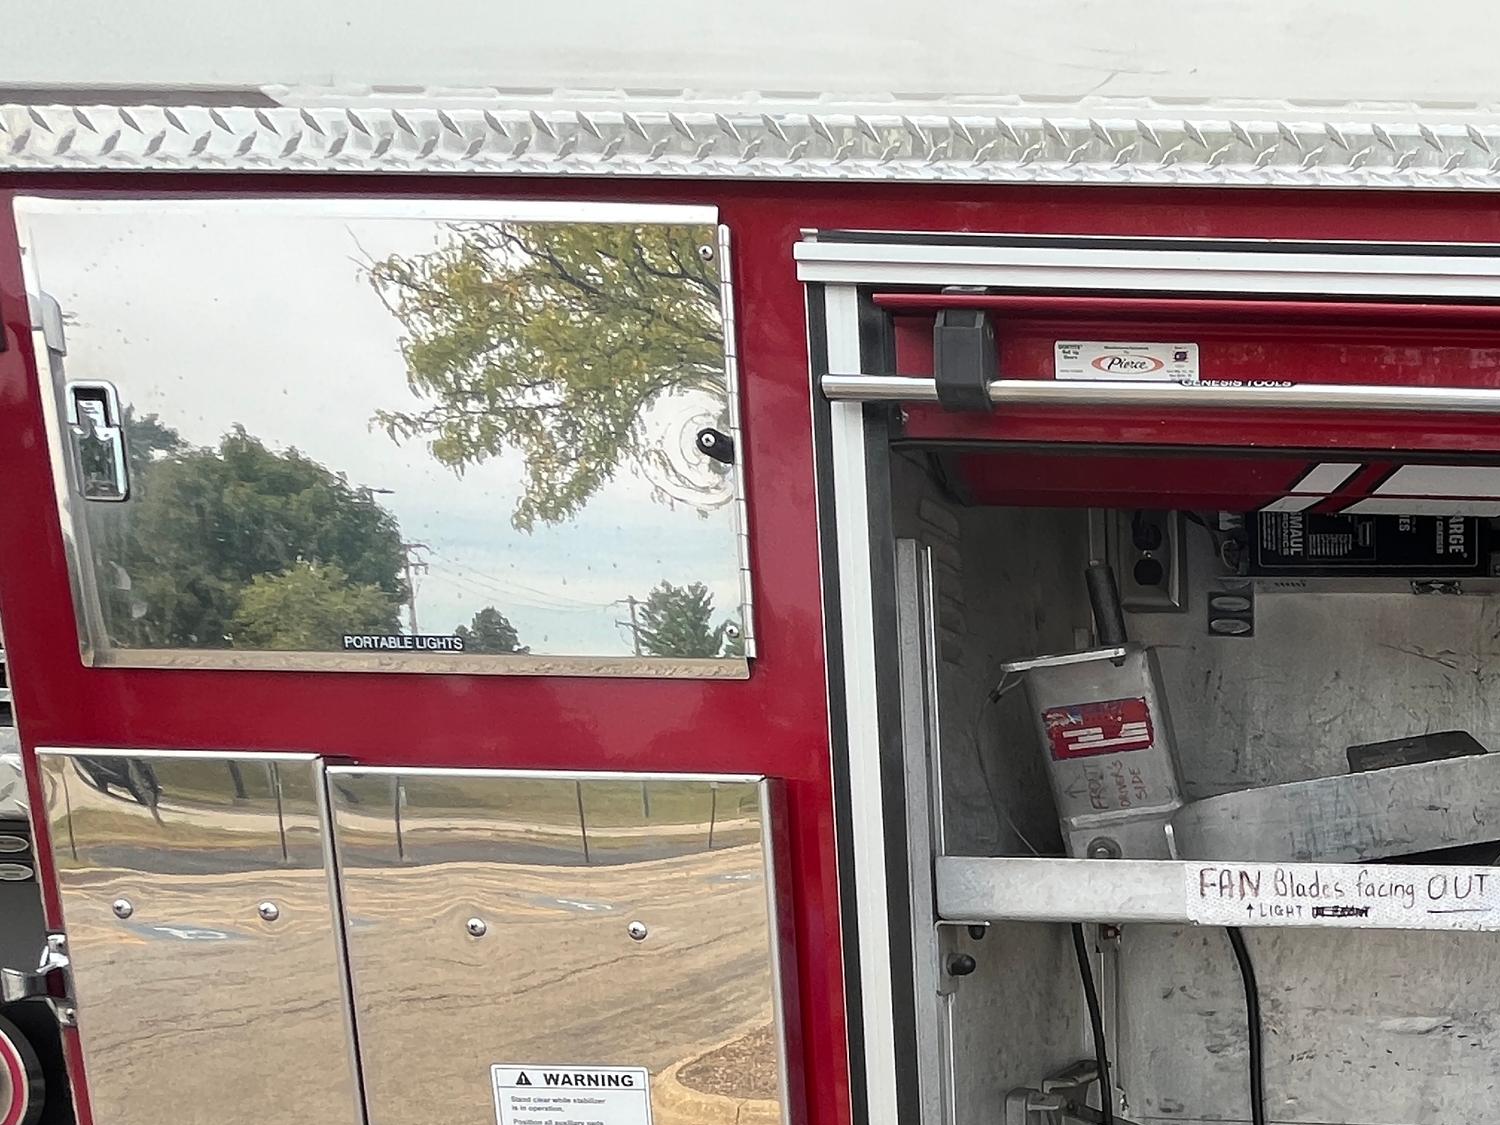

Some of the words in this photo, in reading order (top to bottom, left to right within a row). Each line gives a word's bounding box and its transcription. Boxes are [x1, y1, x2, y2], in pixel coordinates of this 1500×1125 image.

[1107, 357, 1147, 370] Pierce
[343, 635, 413, 649] PORTABLE
[415, 637, 463, 650] LIGHTS
[1128, 767, 1148, 801] SIDE
[1199, 867, 1261, 901] FAN
[1273, 868, 1345, 899] Blades
[1356, 870, 1415, 909] facing
[1427, 873, 1490, 901] OUT
[1260, 904, 1303, 919] LIGHT
[543, 1073, 634, 1087] WARNING
